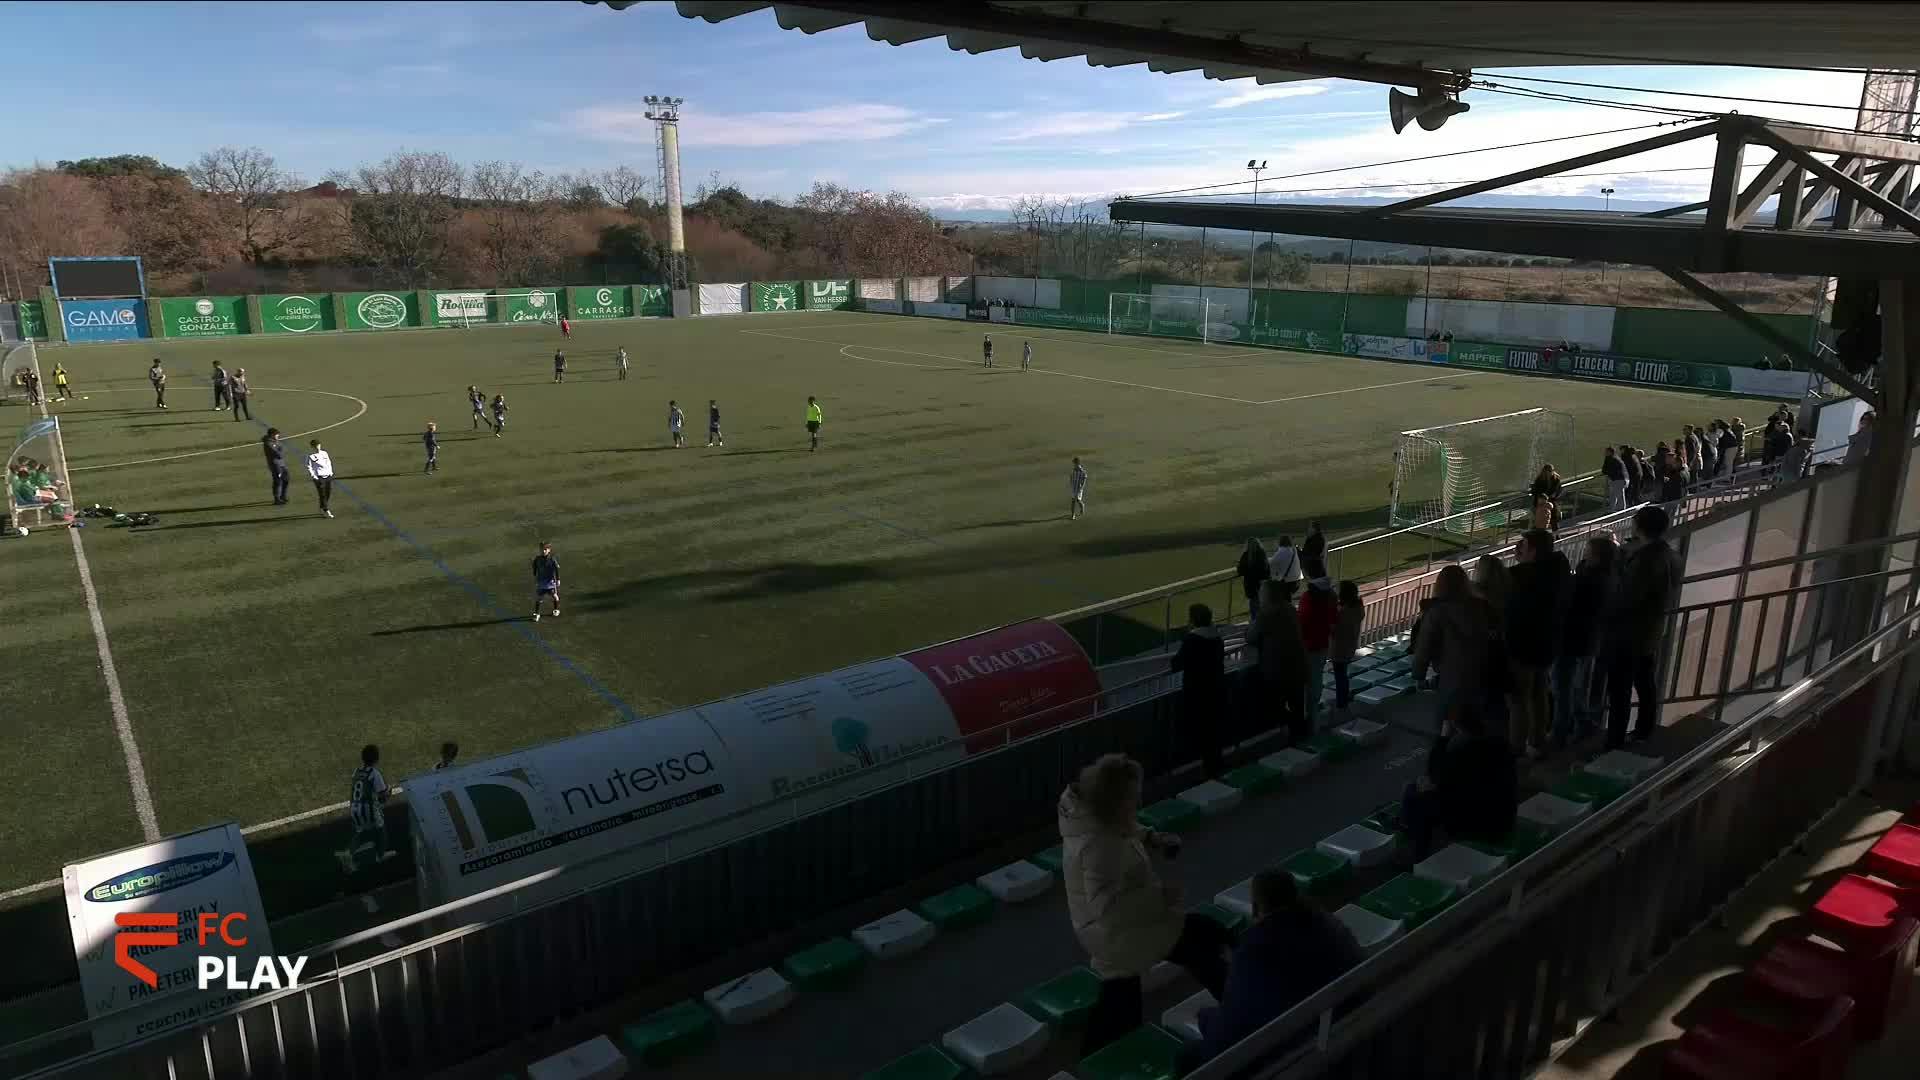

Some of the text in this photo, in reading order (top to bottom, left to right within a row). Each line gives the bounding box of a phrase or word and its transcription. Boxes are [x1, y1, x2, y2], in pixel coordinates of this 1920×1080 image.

[286, 307, 311, 315] Isidro
[441, 299, 484, 309] Rodilla
[578, 306, 631, 314] CARRASCO
[68, 309, 136, 325] GAMO
[178, 316, 221, 324] CASTRO
[1458, 353, 1504, 364] MAPFRE
[1508, 351, 1538, 369] FUTUR
[1574, 356, 1615, 371] TERCERA
[1633, 361, 1669, 383] FUTUR
[929, 663, 977, 686] LA
[968, 641, 1057, 675] GACETA
[561, 750, 714, 814] nutersa
[462, 838, 553, 874] Asesoramiento
[92, 849, 225, 900] Europillow
